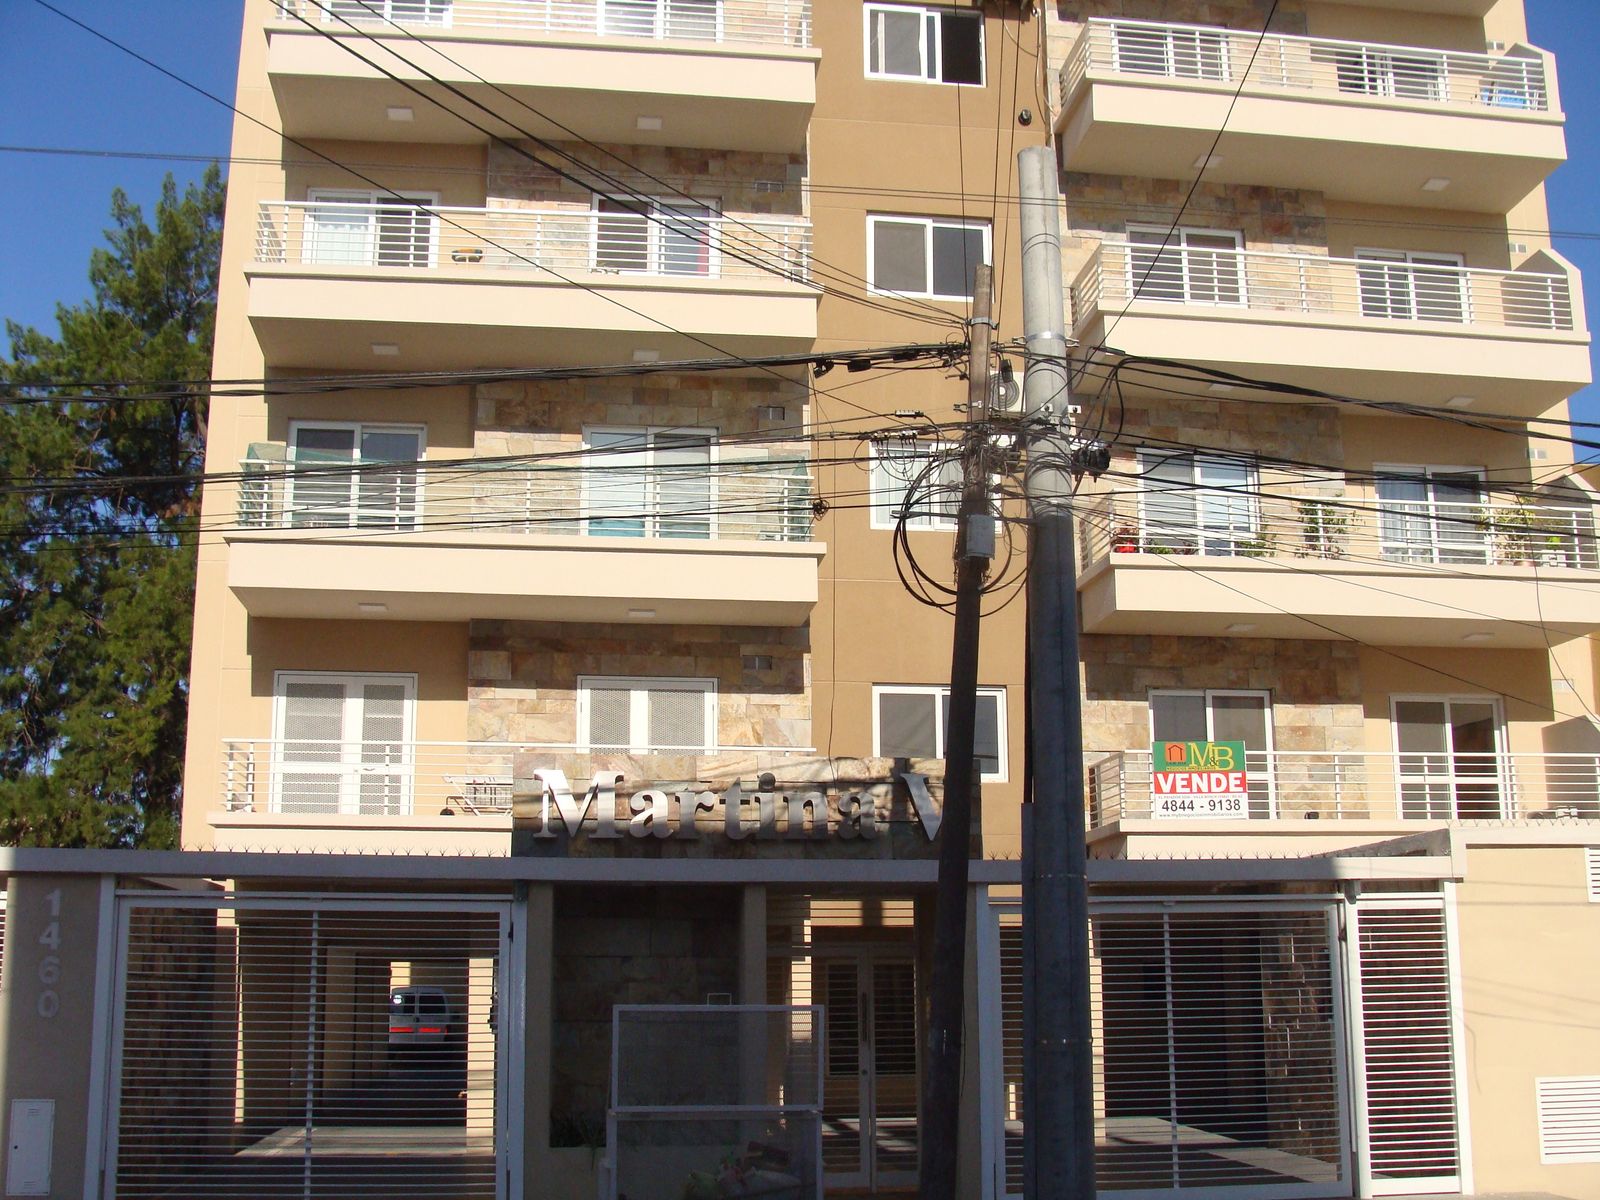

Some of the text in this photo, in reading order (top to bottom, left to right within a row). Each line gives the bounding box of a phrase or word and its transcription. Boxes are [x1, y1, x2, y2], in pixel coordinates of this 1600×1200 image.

[1188, 742, 1234, 771] M&B
[1156, 772, 1244, 793] VENDE
[533, 769, 877, 841] Martina
[1161, 799, 1195, 812] 4844
[1208, 798, 1241, 811] 9138
[37, 888, 61, 1018] 1460
